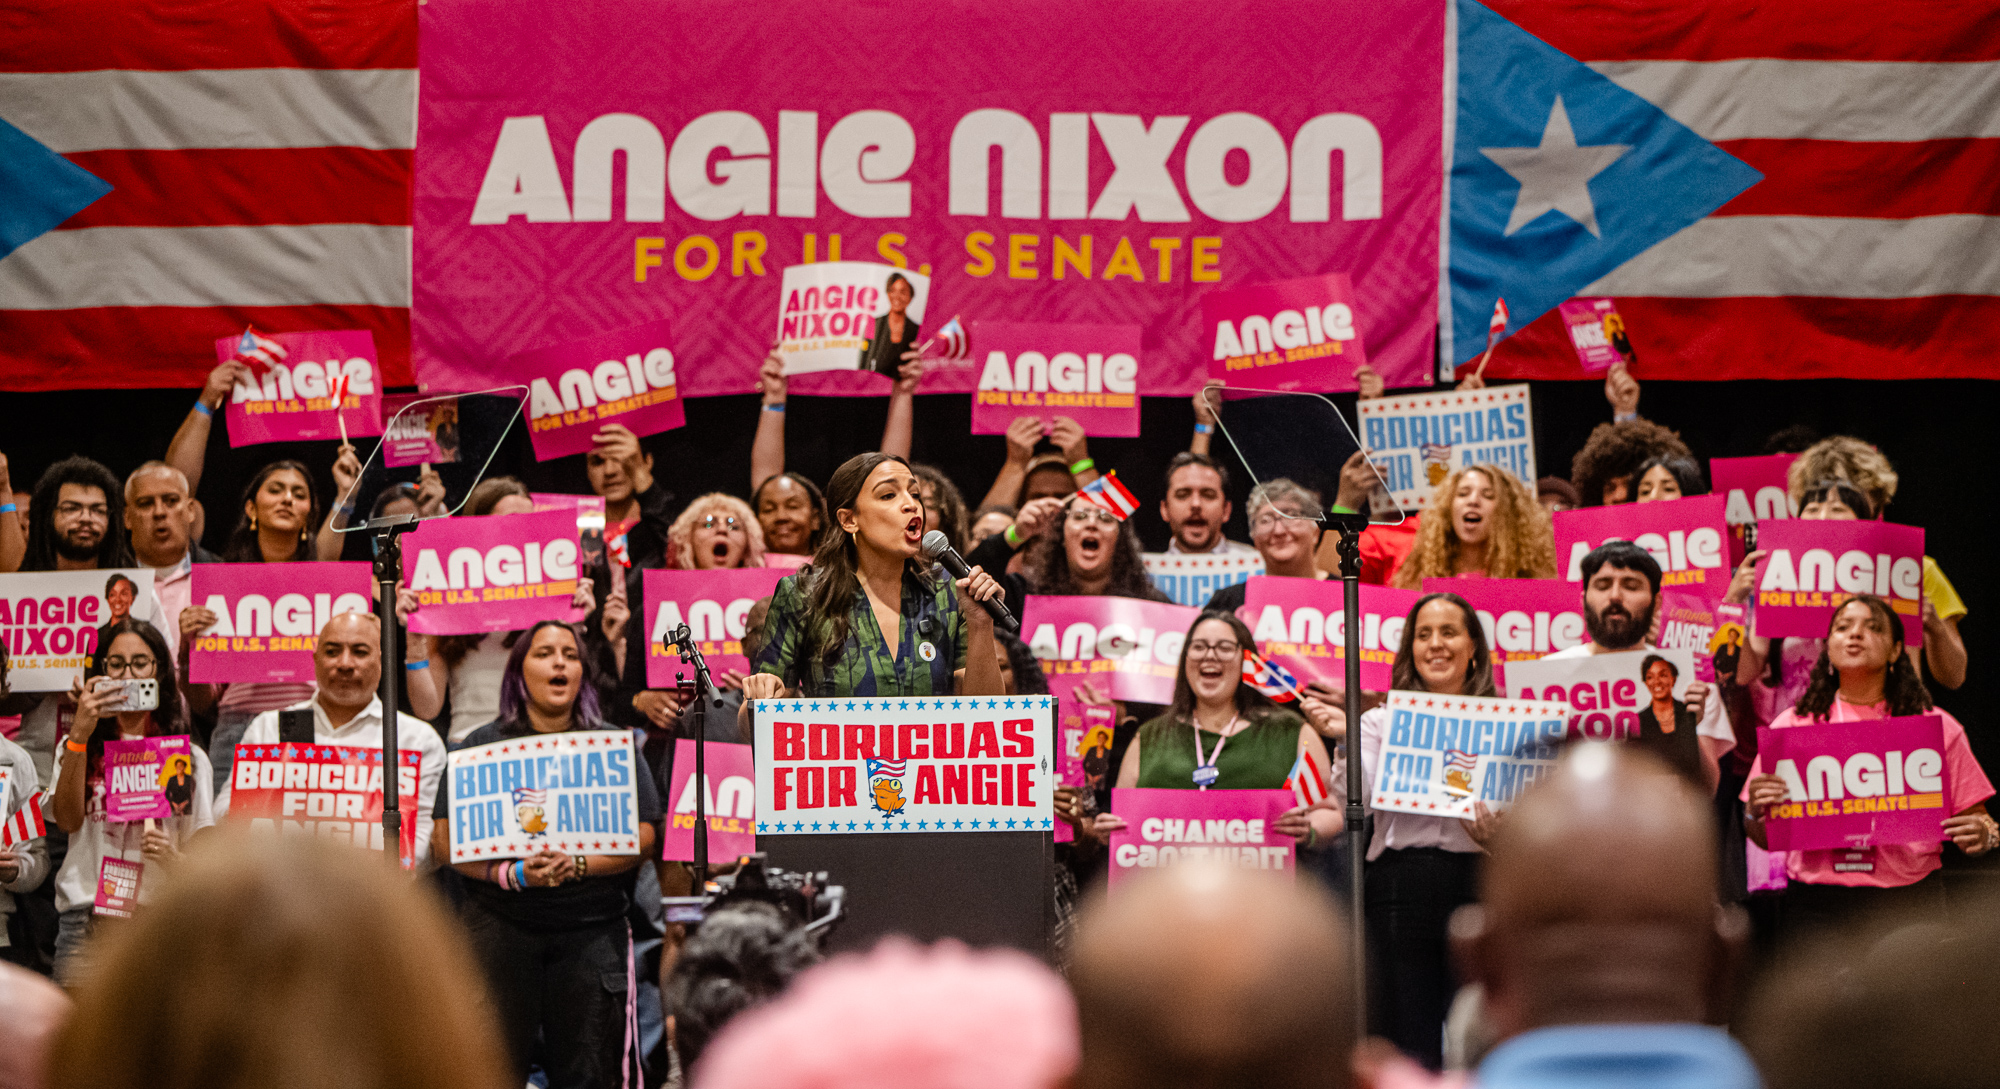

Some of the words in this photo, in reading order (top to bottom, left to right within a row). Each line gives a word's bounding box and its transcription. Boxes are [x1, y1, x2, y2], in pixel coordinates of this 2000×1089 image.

[469, 109, 916, 225] ANGIE
[948, 108, 1383, 222] NIXON
[634, 231, 768, 282] FOR
[804, 232, 932, 278] U.S.
[964, 231, 1222, 283] SENATE
[785, 285, 879, 314] ANGIE
[782, 312, 875, 341] NIXON
[1213, 303, 1354, 360] ANGIE
[978, 351, 1138, 394] ANGIE
[1225, 355, 1253, 371] FOR
[1286, 341, 1343, 362] SENATE
[530, 347, 676, 419] ANGIE
[978, 392, 1009, 405] FOR
[245, 400, 275, 414] FOR
[306, 394, 361, 412] SENTE
[532, 415, 562, 433] FOR
[1366, 403, 1526, 451] BORICUAS
[1370, 454, 1414, 492] OR
[410, 538, 577, 590] ANGIE
[1566, 527, 1722, 582] AGIE
[1759, 548, 1921, 600] ANGIE
[0, 595, 100, 625] ANGIE
[418, 591, 443, 605] OR
[446, 588, 480, 605] U.S.
[482, 584, 546, 602] SENATE
[1759, 591, 1792, 607] FOR
[1795, 591, 1828, 607] U.S.
[651, 598, 756, 642] ANG
[1254, 604, 1407, 653] ANGIE
[1661, 620, 1714, 654] ANGIE
[17, 658, 41, 669] U.S.
[196, 637, 229, 651] FOR
[232, 637, 266, 652] U.S.
[269, 636, 318, 652] SENA
[1030, 621, 1187, 666] ANGIE
[773, 719, 1034, 761] BORICUAS
[1388, 709, 1562, 760] BORICUAS
[111, 763, 161, 794] ANGIE
[235, 761, 417, 796] BORICUAS
[455, 749, 629, 800] BORICUAS
[774, 766, 857, 811] FOR
[914, 764, 1036, 807] ANGIE
[1380, 752, 1432, 794] FOR
[1481, 761, 1558, 802] ANG
[1774, 748, 1943, 802] ANGIE
[282, 792, 365, 818] FOR
[456, 799, 504, 844] FOR
[557, 792, 633, 835] ANGIE
[1770, 803, 1803, 819] FOR
[1806, 800, 1840, 818] U.S.
[1842, 795, 1908, 814] SENATE
[710, 817, 745, 834] U.S.
[1141, 817, 1265, 844] CHANGE
